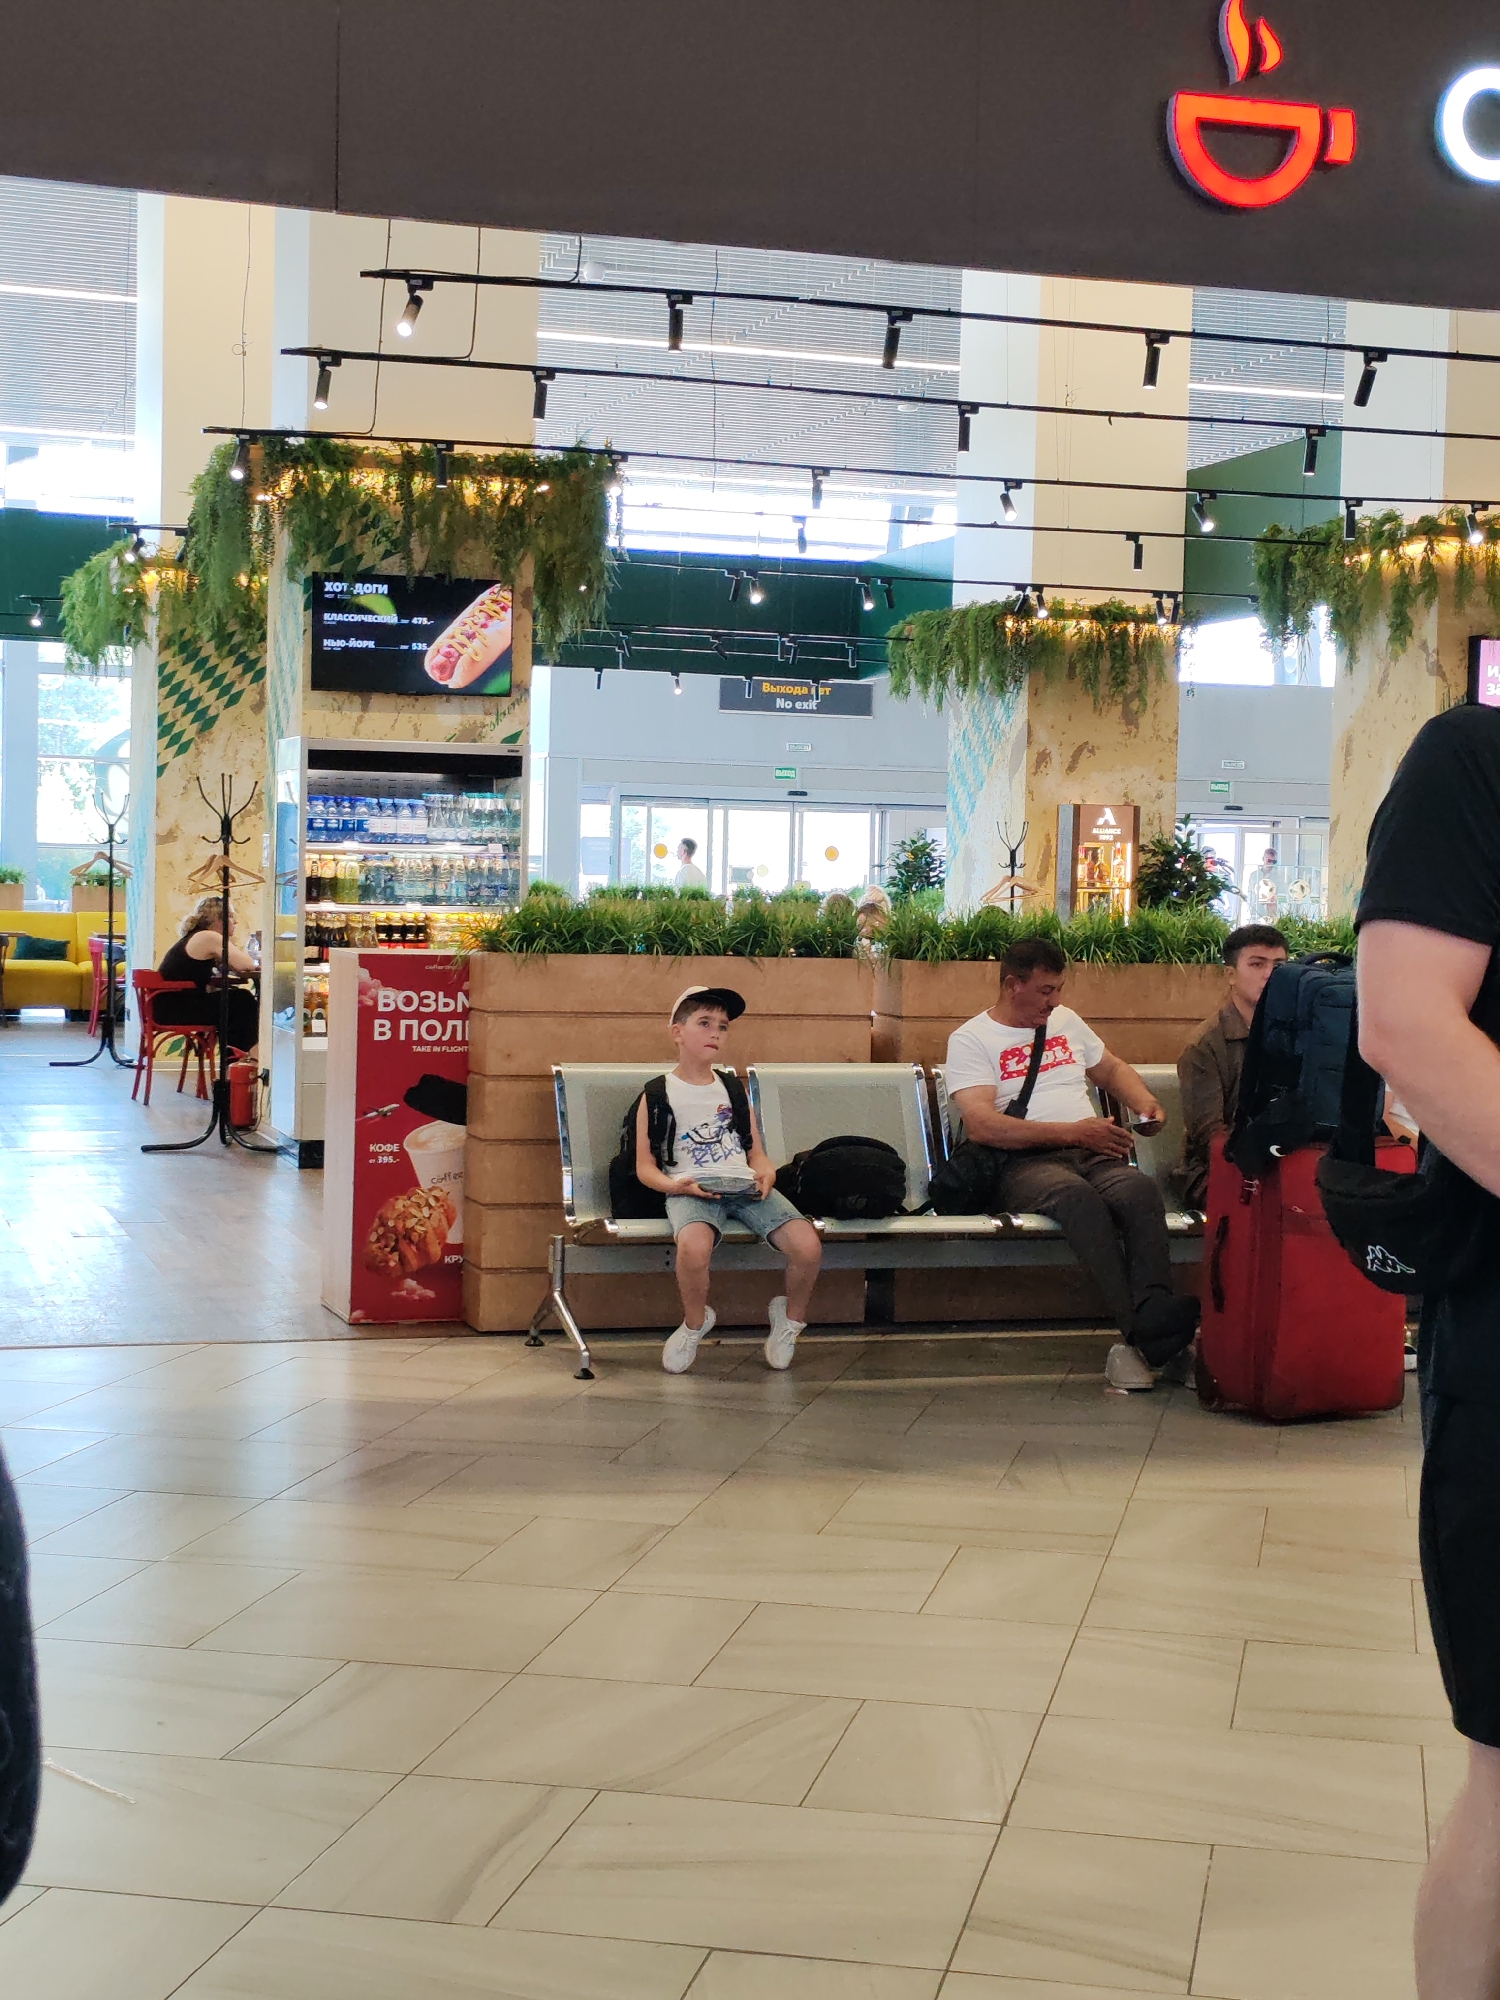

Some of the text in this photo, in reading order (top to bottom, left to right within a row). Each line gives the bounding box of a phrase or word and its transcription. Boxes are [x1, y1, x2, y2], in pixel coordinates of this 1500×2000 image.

[323, 612, 399, 624] КЛАССИЧЕСКИЙ
[322, 637, 376, 649] НЬЮ-ЙОРК
[761, 681, 809, 696] Выхода
[775, 697, 818, 710] No exit
[1092, 827, 1122, 835] ALLIANCE
[373, 1018, 392, 1041] В
[412, 1045, 469, 1053] TAKE IN FLIGHT
[369, 1142, 401, 1153] КОФЕ
